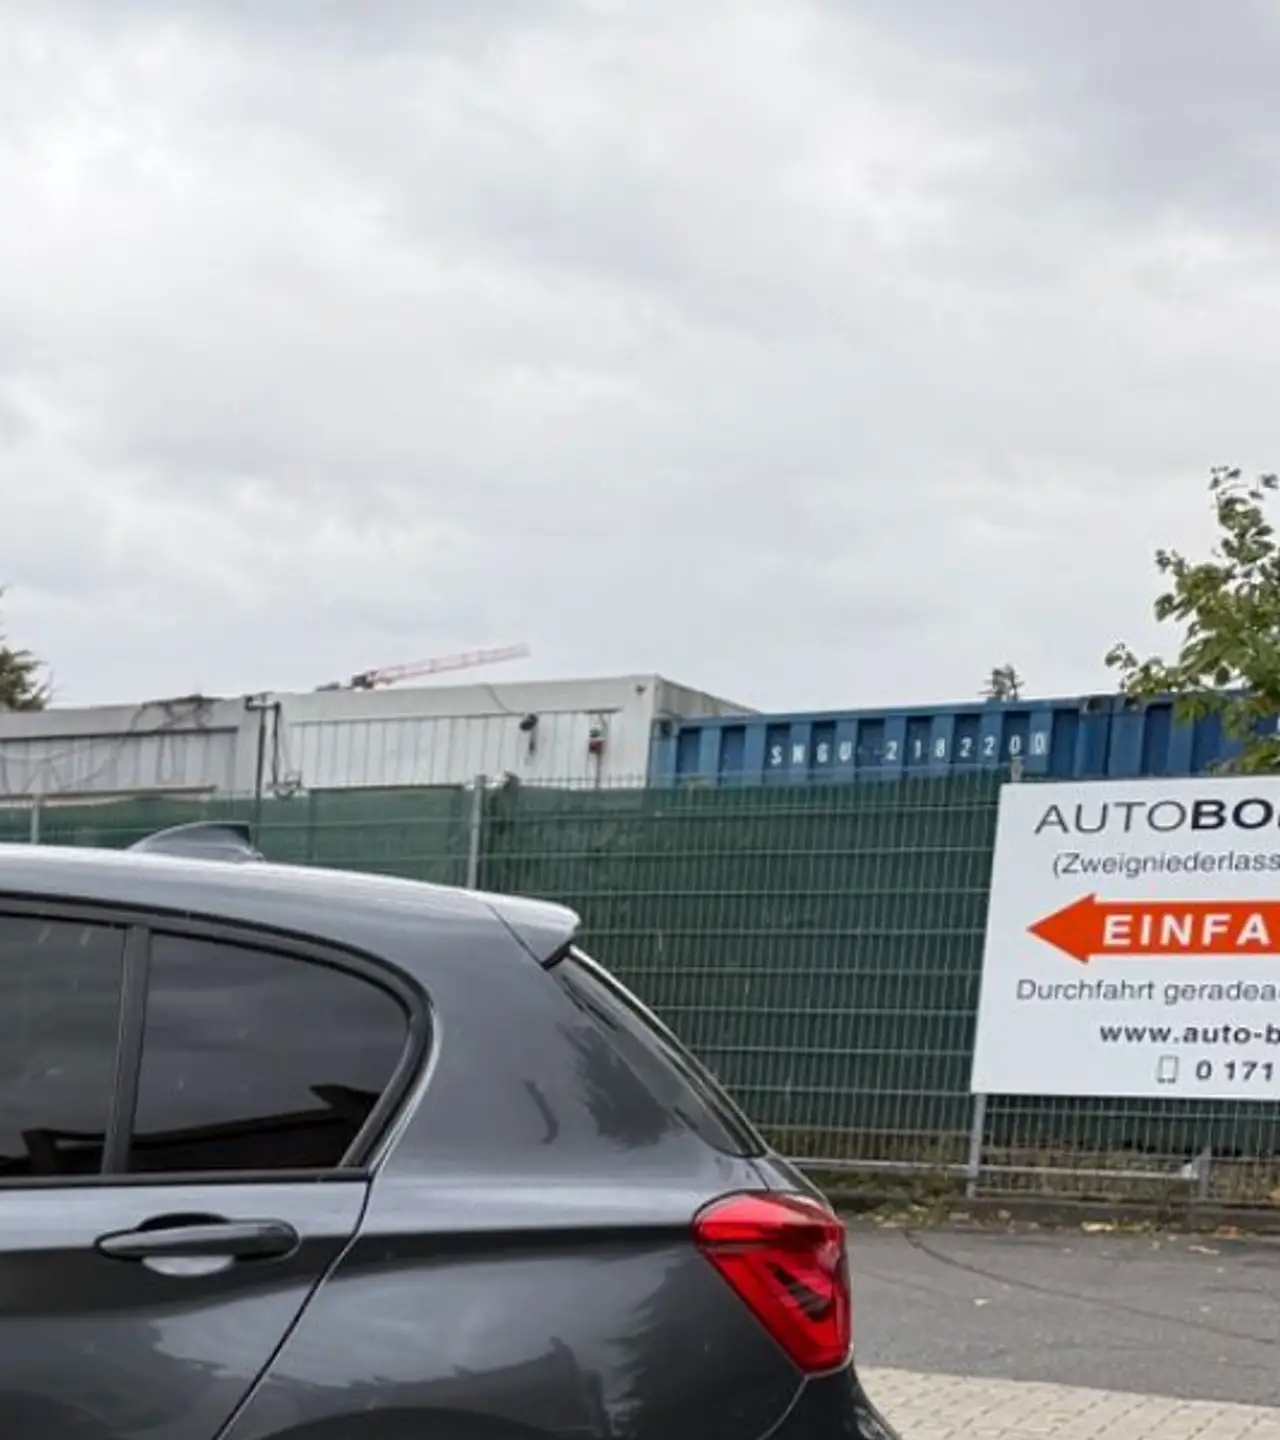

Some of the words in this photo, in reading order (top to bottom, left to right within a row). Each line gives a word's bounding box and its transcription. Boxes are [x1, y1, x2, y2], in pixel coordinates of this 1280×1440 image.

[1035, 799, 1280, 834] AUTOBO
[1102, 913, 1271, 946] EINFA
[1016, 978, 1155, 1001] Durchfahrt
[1164, 979, 1280, 1006] geradea
